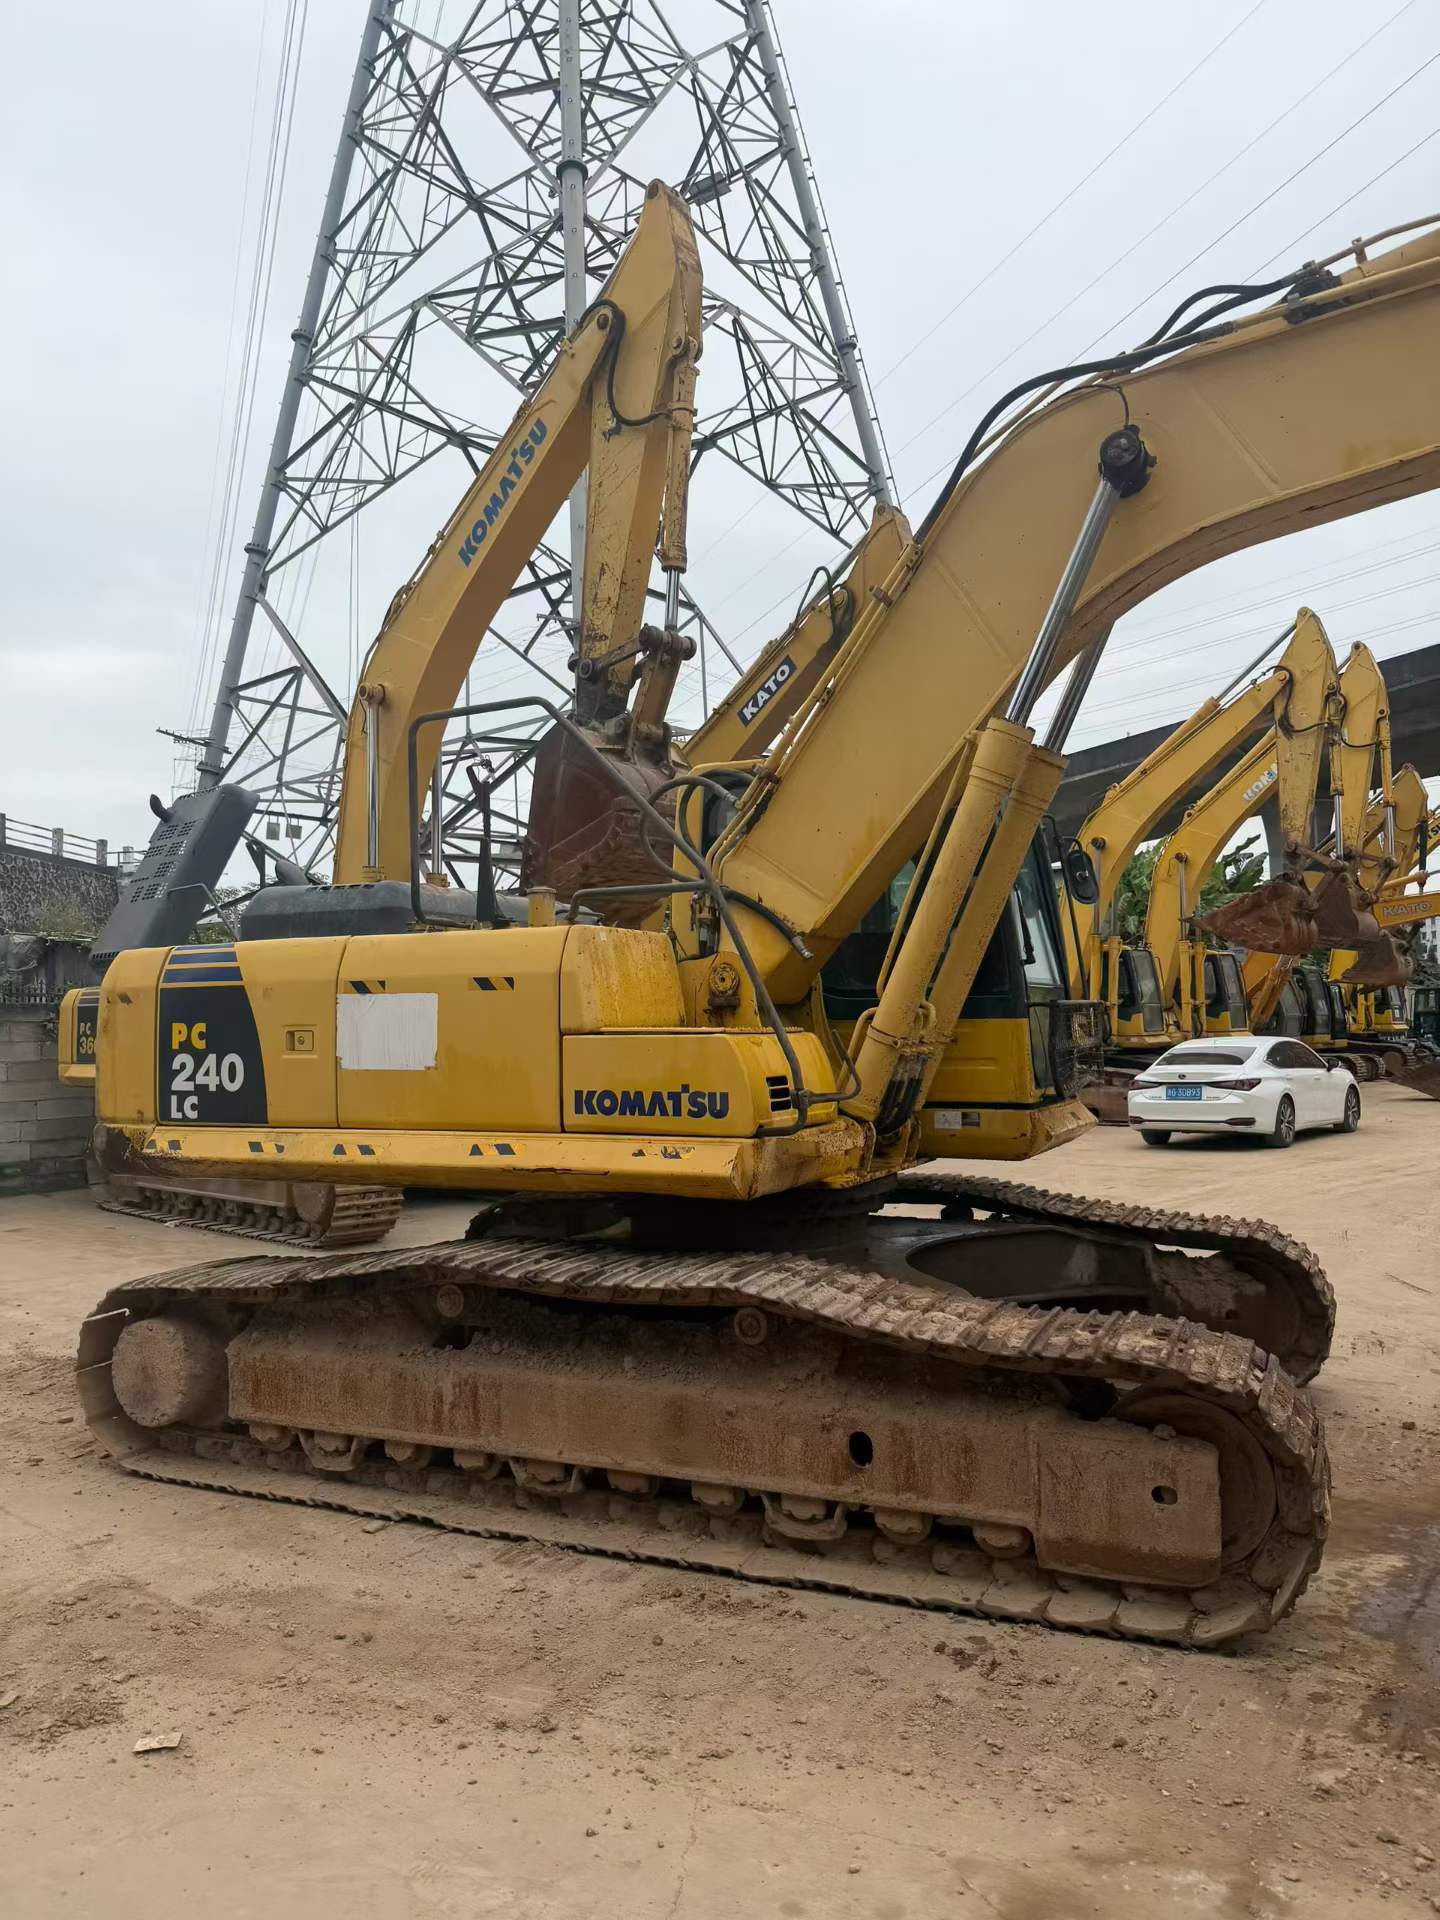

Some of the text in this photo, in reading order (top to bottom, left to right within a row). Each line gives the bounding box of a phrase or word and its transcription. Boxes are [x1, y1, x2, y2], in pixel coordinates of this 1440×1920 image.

[458, 418, 547, 567] KOMATSU
[742, 664, 790, 721] KATO
[172, 1022, 206, 1050] PC
[171, 1053, 245, 1092] 240
[170, 1095, 199, 1119] LC
[574, 1084, 730, 1119] KOMATSU
